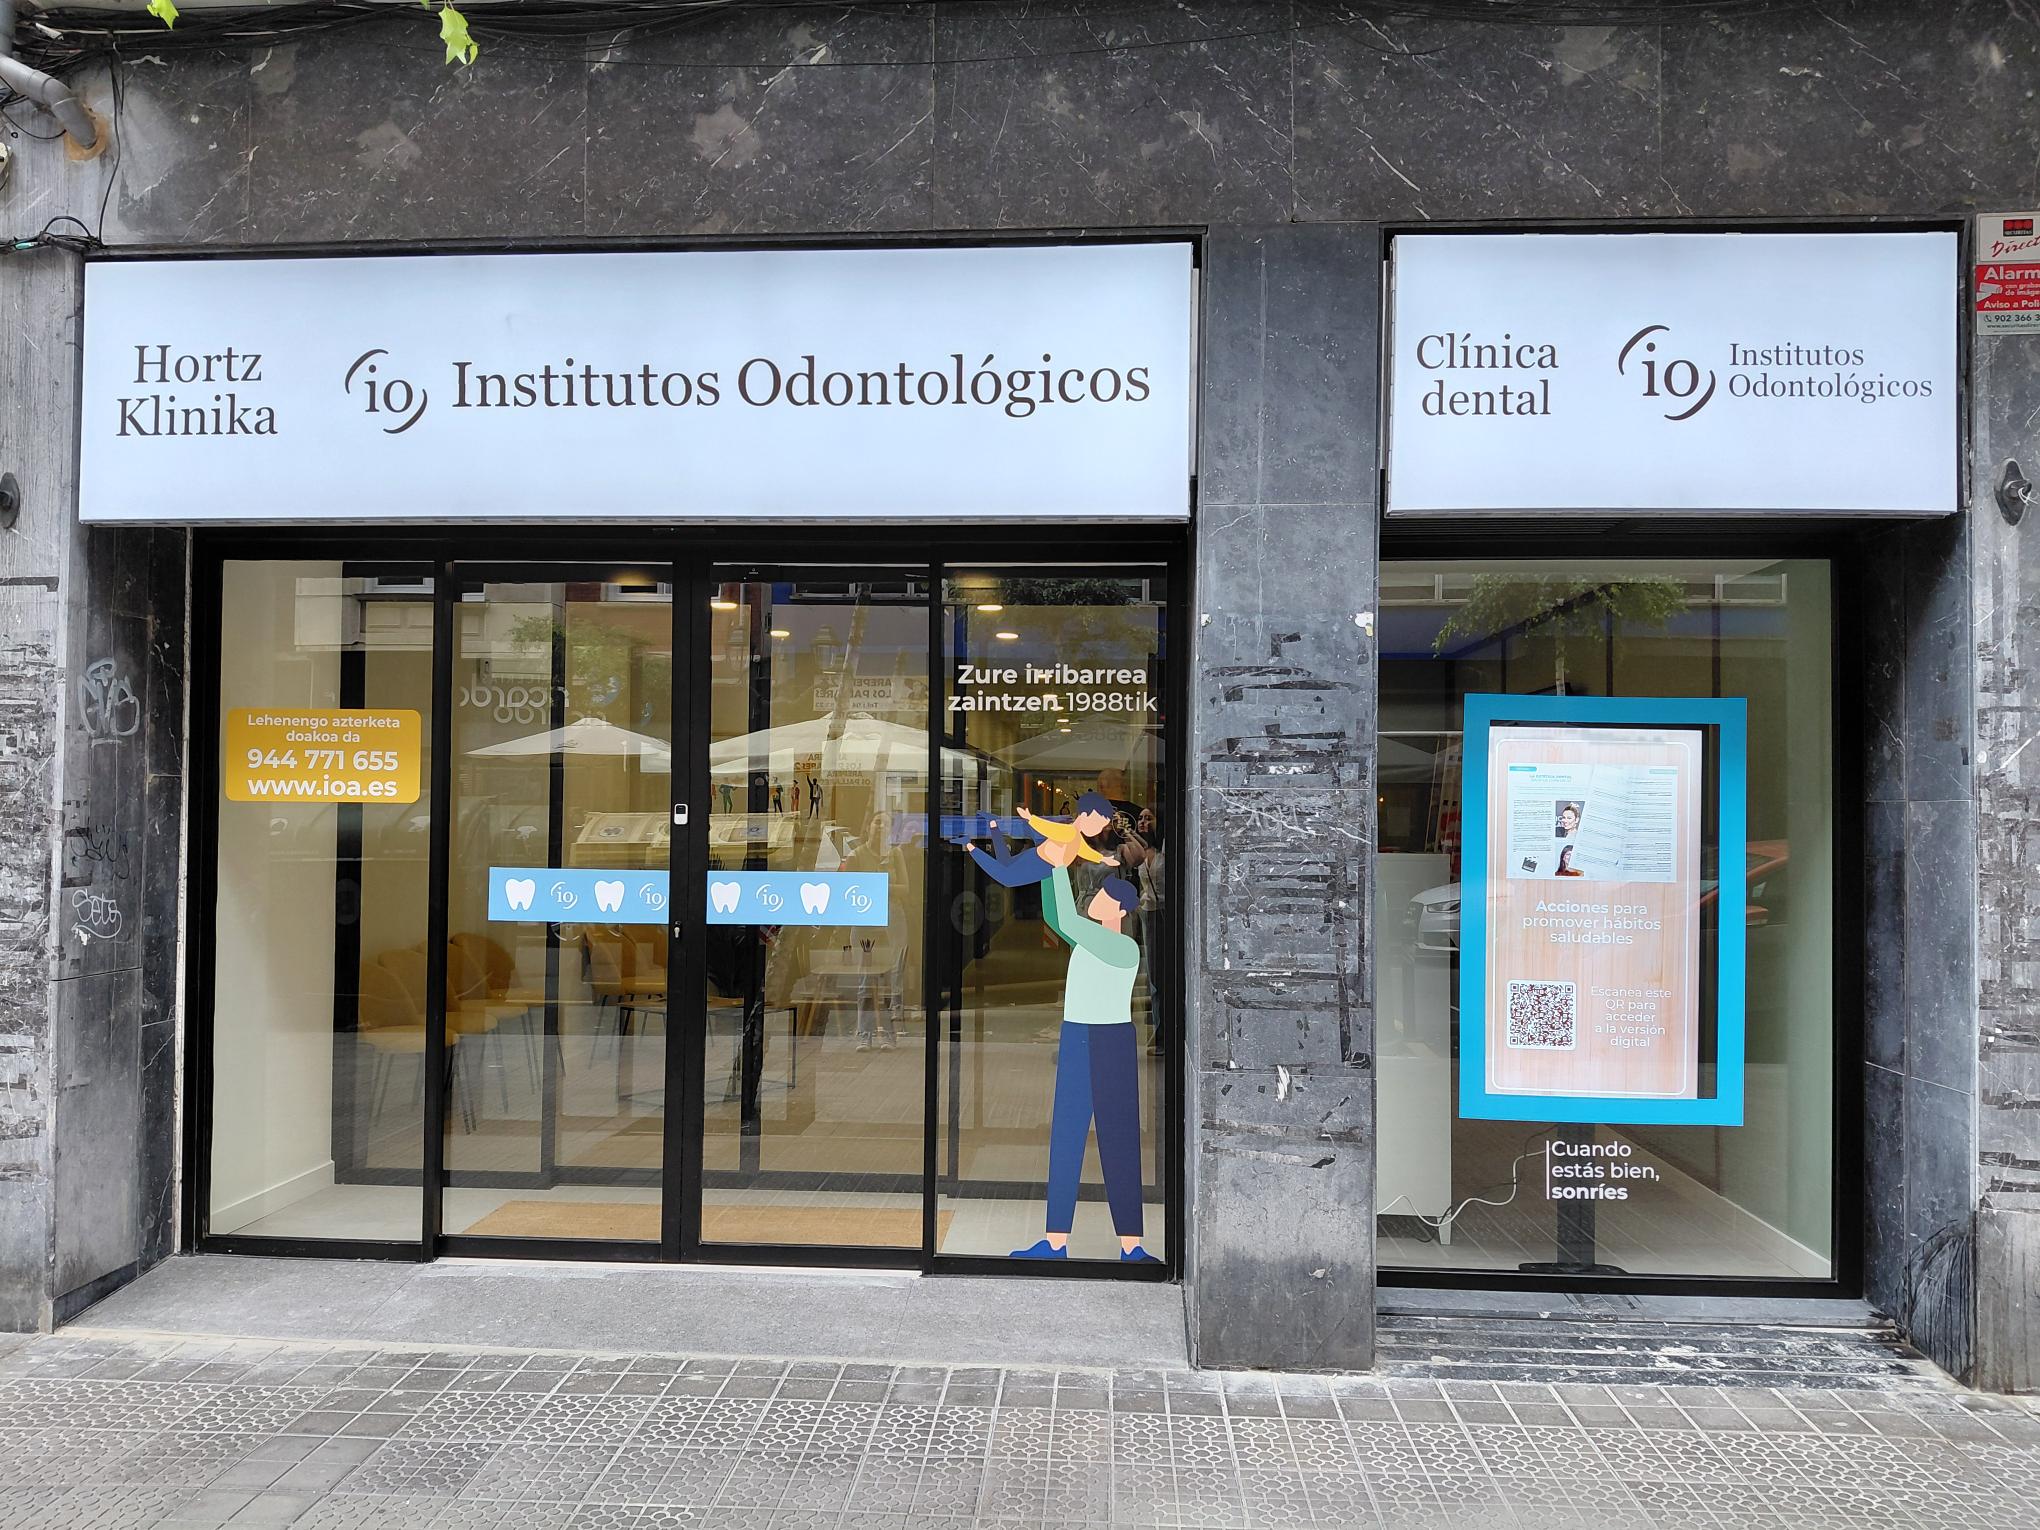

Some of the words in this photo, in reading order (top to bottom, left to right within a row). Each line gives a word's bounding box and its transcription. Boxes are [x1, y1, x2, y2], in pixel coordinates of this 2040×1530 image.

[1984, 265, 2040, 280] Alarm
[1984, 301, 2010, 309] Aviso
[2021, 299, 2040, 308] Poli
[2014, 314, 2032, 322] 366
[1416, 332, 1559, 370] Clínica
[1729, 342, 1865, 367] Institutos
[133, 344, 263, 384] Hortz
[452, 357, 721, 408] Institutos
[737, 352, 1151, 419] Odontológicos
[1728, 372, 1933, 404] Odontológicos
[1421, 379, 1552, 417] dental
[115, 393, 279, 437] Klinika
[957, 664, 1018, 685] Zure
[1025, 662, 1148, 685] irribarrea
[947, 690, 1059, 712] zaintzen
[1065, 691, 1158, 712] 1988tik
[247, 714, 328, 729] Lehenengo
[332, 716, 400, 728] azterketa
[286, 730, 339, 742] doakoa
[342, 731, 360, 743] da
[247, 748, 298, 769] 944
[304, 749, 345, 770] 771
[353, 750, 399, 771] 655
[247, 774, 398, 796] www.ioa.es
[1535, 900, 1609, 914] Acciones
[1613, 904, 1648, 918] para
[1522, 917, 1599, 929] promover
[1603, 916, 1661, 930] hábitos
[1550, 931, 1633, 945] saludables
[1591, 986, 1642, 998] Escanea
[1645, 988, 1672, 998] este
[1605, 999, 1625, 1010] QR
[1628, 1002, 1656, 1012] para
[1605, 1011, 1656, 1022] acceder
[1595, 1025, 1602, 1033] a
[1606, 1022, 1617, 1033] la
[1620, 1023, 1666, 1035] versión
[1610, 1035, 1651, 1048] digital
[1551, 1140, 1632, 1158] Cuando
[1551, 1162, 1605, 1179] estás
[1610, 1161, 1660, 1182] bien,
[1551, 1184, 1629, 1200] sonríes
